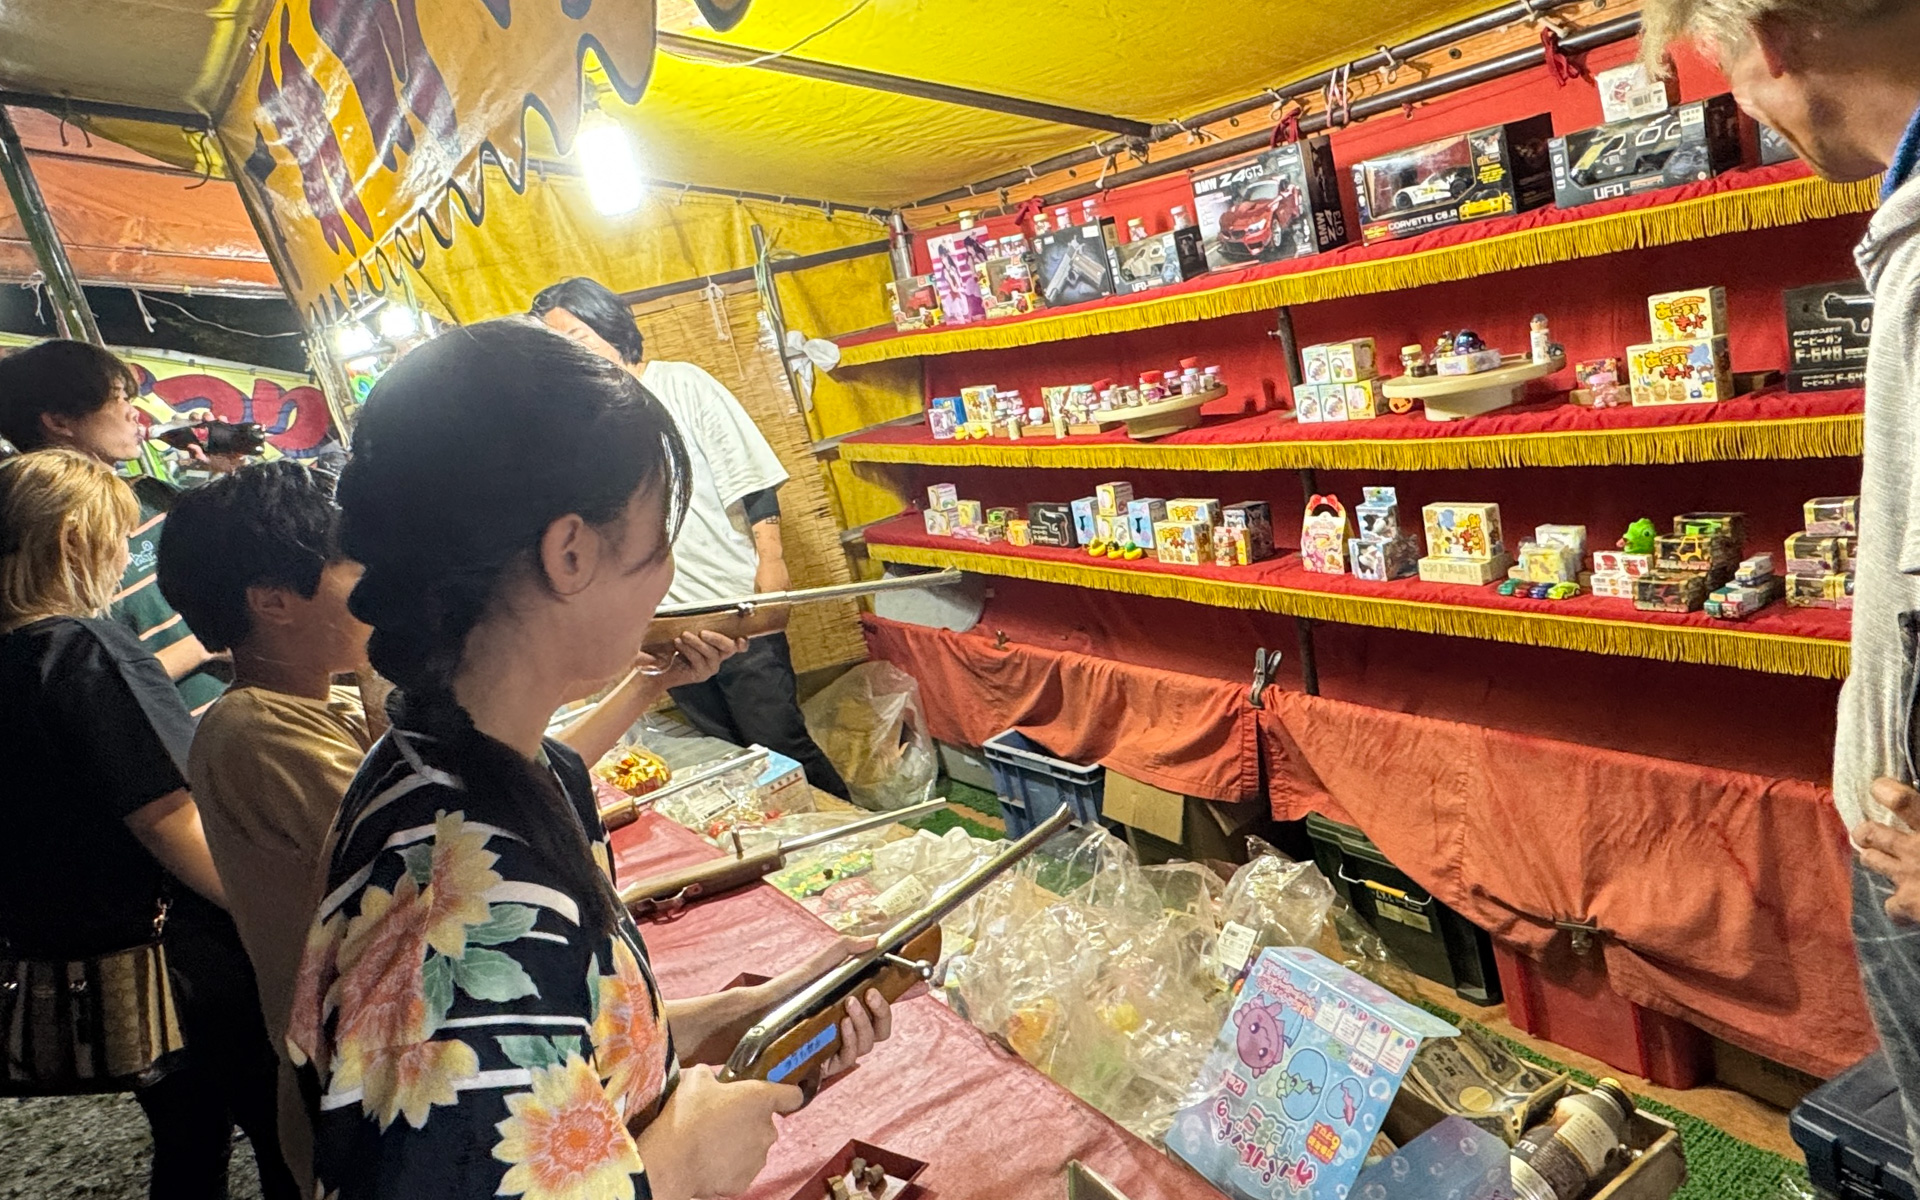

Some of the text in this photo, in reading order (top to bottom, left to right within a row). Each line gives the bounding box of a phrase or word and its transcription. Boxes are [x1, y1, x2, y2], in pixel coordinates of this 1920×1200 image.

[1194, 164, 1264, 194] BMW Z4 GT3
[1315, 212, 1329, 246] BMW
[1387, 214, 1434, 231] CORVETTE
[1835, 372, 1867, 384] F-64
[1235, 1104, 1295, 1157] たまご
